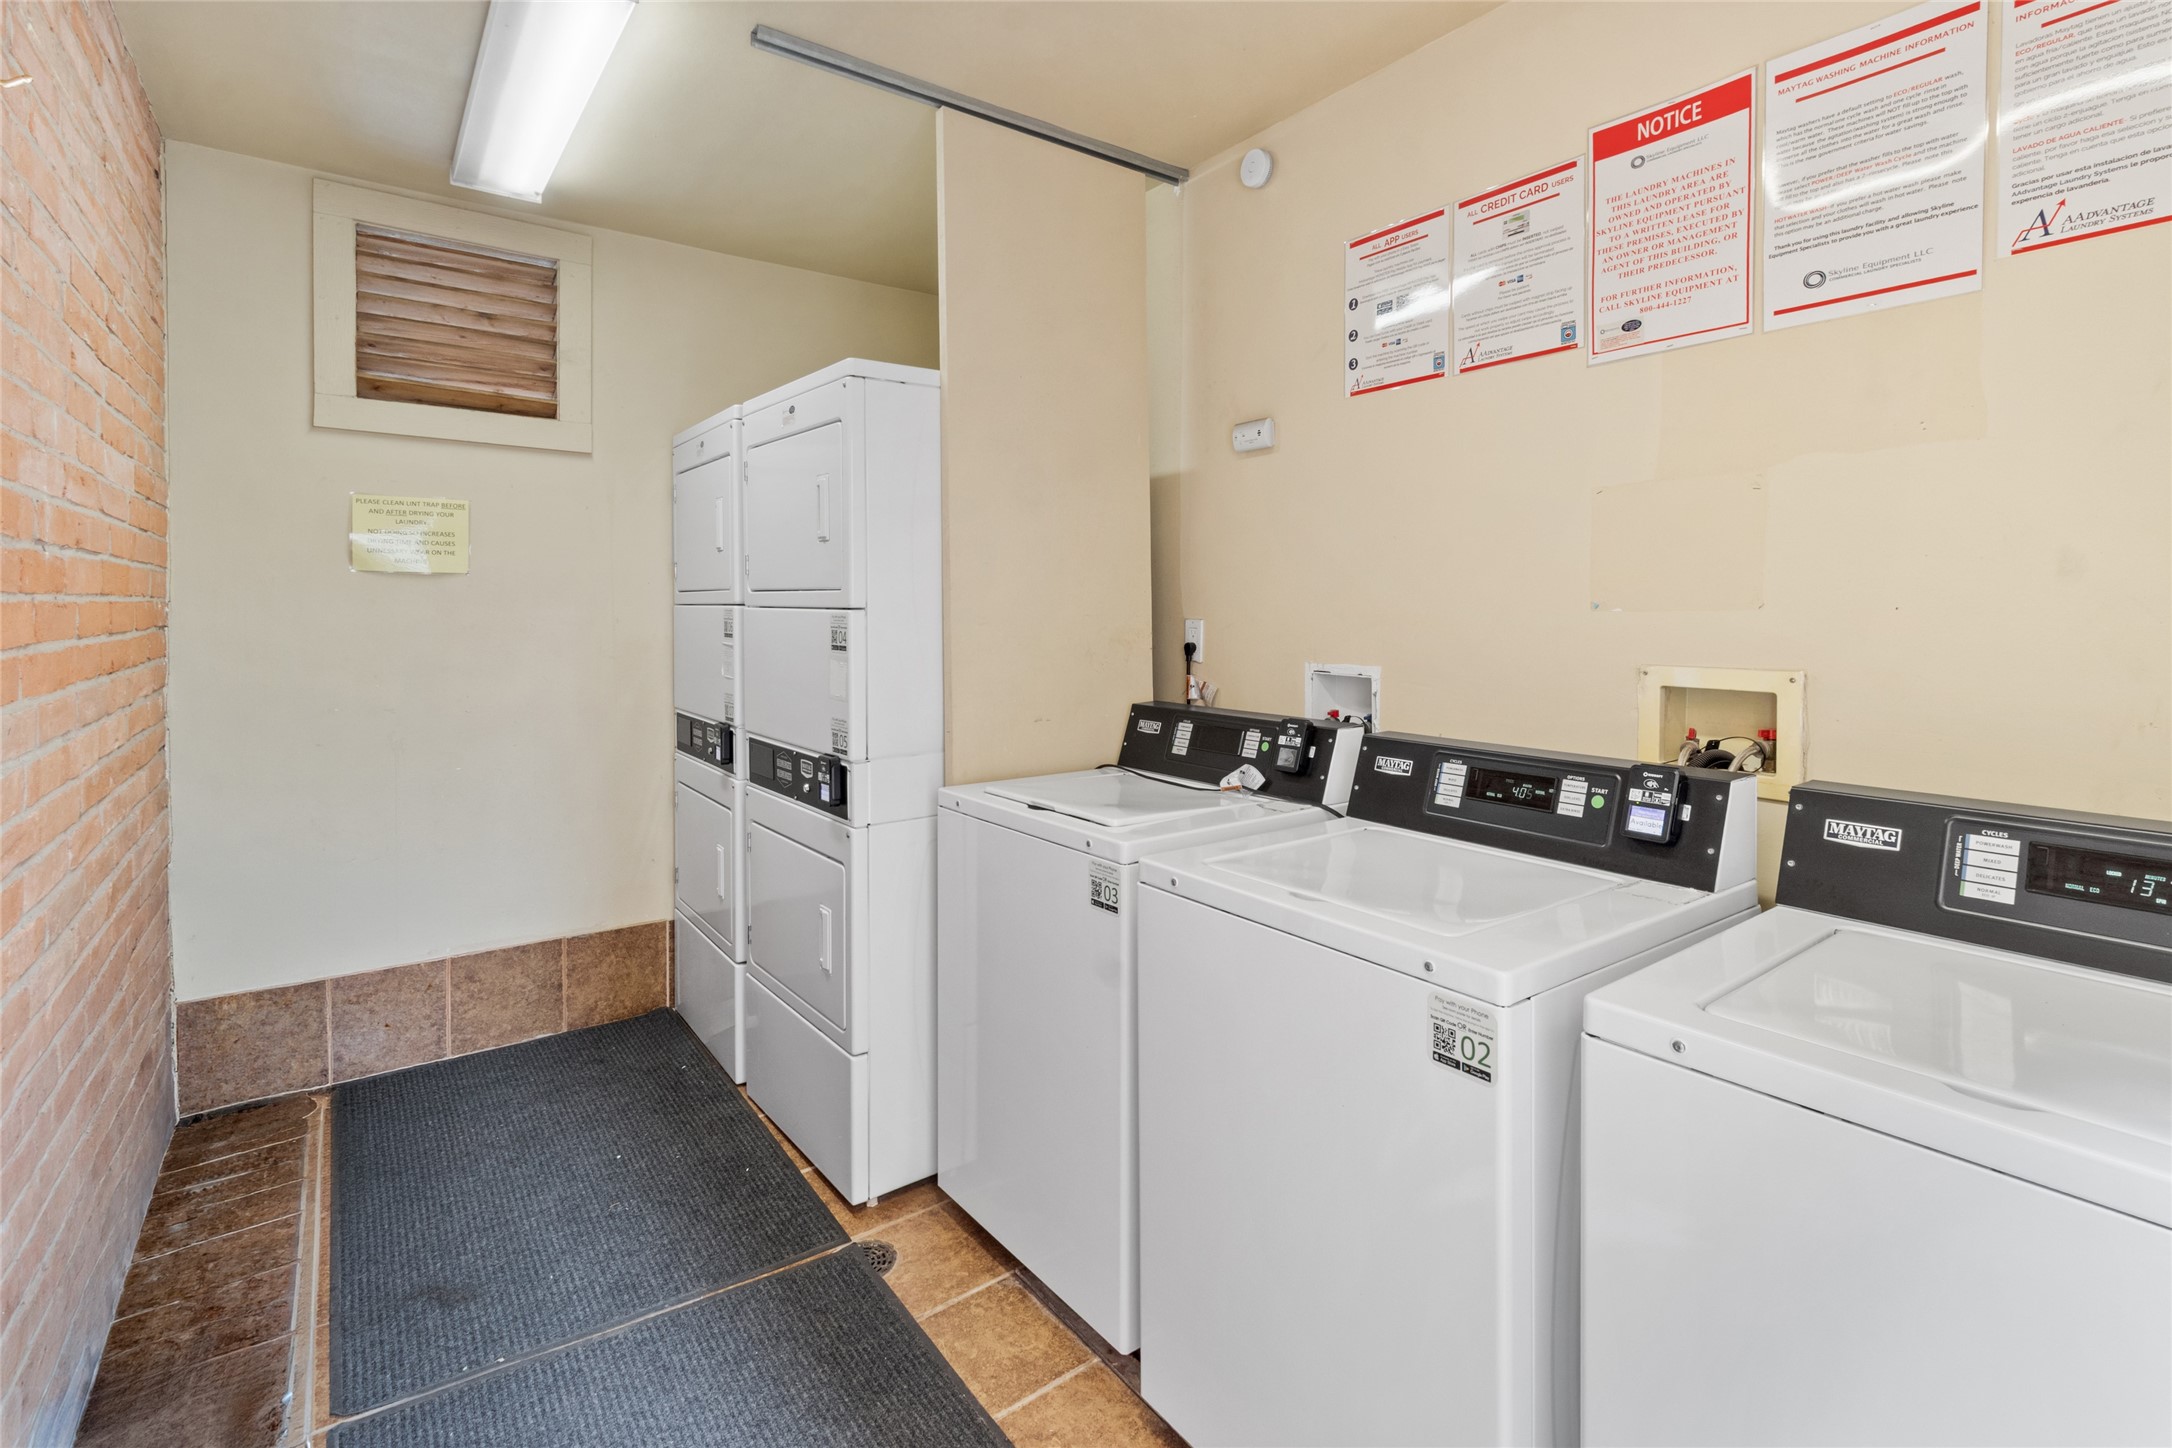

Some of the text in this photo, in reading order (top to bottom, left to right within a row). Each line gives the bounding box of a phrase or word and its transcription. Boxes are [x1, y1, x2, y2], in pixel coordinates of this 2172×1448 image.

[1777, 20, 1974, 97] MAYTAG WASHING MACHINE INFORMATION
[1893, 76, 1942, 97] ECO/REGULAR
[1637, 99, 1702, 141] NOTICE
[2012, 140, 2044, 154] LAVADO
[2058, 129, 2081, 141] AGUA
[1606, 157, 1735, 205] THE LAUNDRY MACHINES IN
[2011, 148, 2151, 190] Gracias por usar esta instalacion de
[2011, 180, 2057, 198] AAdvantage
[2059, 172, 2091, 186] Laundry
[2093, 162, 2127, 177] Systems
[1467, 174, 1573, 217] ALL CREDIT CARD USERS
[1608, 179, 1731, 224] OWNED AND OPERATED BY
[1611, 169, 1728, 213] THIS LAUNDRY AREA ARE
[2011, 191, 2052, 206] experencia
[2054, 187, 2064, 196] de
[1596, 186, 1745, 237] SKYLINE EQUIPMENT PURSUANT
[1609, 201, 1729, 243] TO A WRITTEN LEASE FOR
[1774, 242, 1790, 251] Thank
[1803, 236, 1811, 244] for
[1812, 232, 1828, 241] using
[1829, 229, 1839, 237] this
[1841, 223, 1863, 234] laundry
[1865, 218, 1885, 228] facility
[1888, 214, 1899, 222] and
[1901, 207, 1928, 219] allowing
[1930, 200, 1954, 212] Skyline
[2060, 205, 2153, 233] LAUNDRY SYSTEMS
[1372, 228, 1418, 250] ALL APP USERS
[1597, 208, 1744, 256] THESE PREMISES, EXECUTED BY
[1602, 220, 1737, 264] AN OWNER OR MANAGEMENT
[1768, 247, 1798, 259] Equipment
[1799, 239, 1829, 252] Specialists
[1838, 231, 1861, 242] provide
[1862, 228, 1874, 236] you
[1875, 224, 1888, 233] with
[1895, 218, 1912, 228] great
[1914, 212, 1938, 223] laundry
[1940, 202, 1978, 217] experience
[1600, 231, 1738, 274] AGENT OF THIS BUILDING, OR
[1618, 247, 1717, 280] THEIR PREDECESSOR.
[1828, 247, 1932, 278] Skyline Equipment LLC
[1599, 273, 1738, 313] CALL SKYLINE EQUIPMENT AT
[1600, 263, 1737, 304] FOR FURTHER INFORMATION,
[1639, 295, 1691, 314] 800-444-1227
[1140, 721, 1159, 730] MAYTAG
[1378, 758, 1410, 770] MAYTAG
[1829, 822, 1896, 842] MAYTAG
[1838, 835, 1883, 846] COMMERCIAL
[1976, 841, 2013, 849] POWERWASH
[1981, 830, 2008, 838] CYCLES
[1976, 873, 2006, 881] DELICATES
[2130, 880, 2155, 897] 13
[1104, 885, 1118, 904] 03
[1446, 999, 1456, 1007] with
[1471, 1008, 1489, 1019] Phone
[1461, 1035, 1491, 1068] 02
